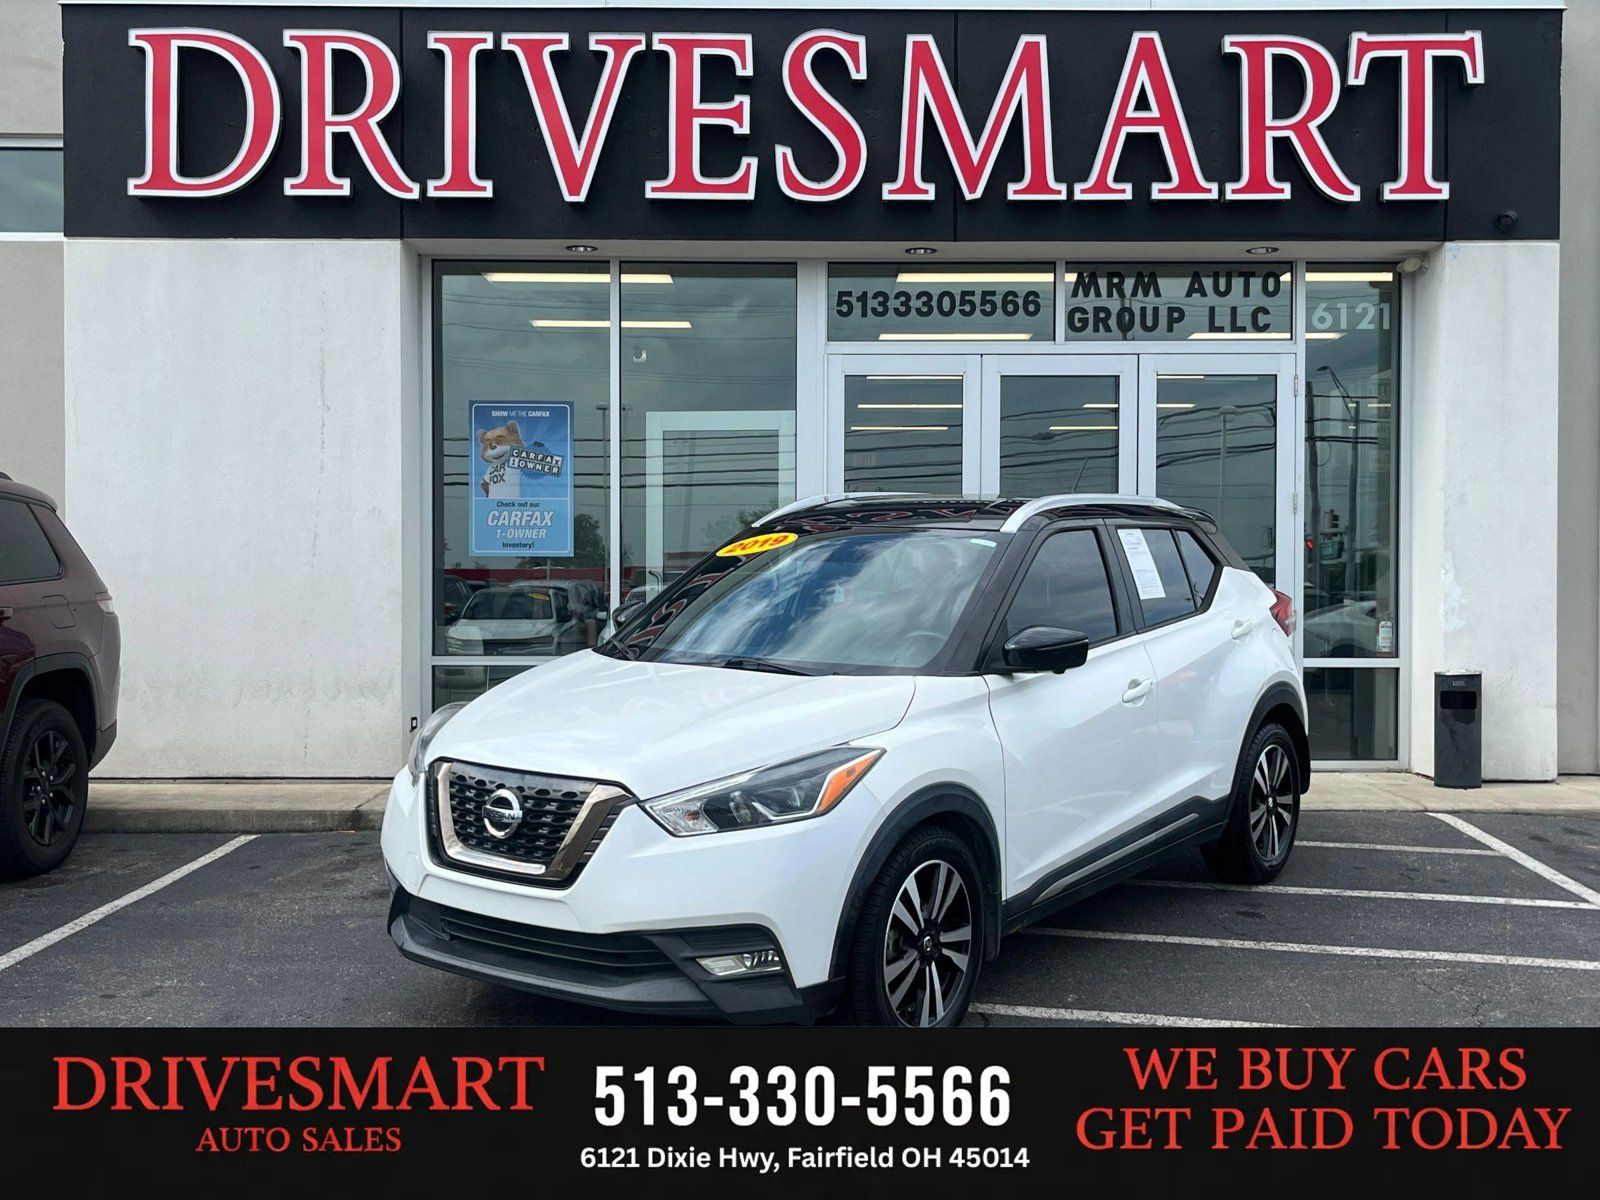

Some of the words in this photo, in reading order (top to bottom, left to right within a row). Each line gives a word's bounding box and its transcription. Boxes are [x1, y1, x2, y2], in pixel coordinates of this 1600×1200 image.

[127, 27, 1485, 203] DRIVESMART
[1071, 271, 1162, 298] MRM
[1185, 271, 1281, 298] AUTO
[836, 290, 1041, 318] 5133305566
[1067, 306, 1186, 333] GROUP
[1208, 306, 1271, 333] LLC
[1311, 302, 1390, 330] 6121
[512, 449, 561, 465] CARFAX
[489, 463, 506, 475] CAR
[519, 460, 559, 474] OWNER
[489, 473, 506, 484] FOX
[496, 500, 516, 508] Check
[487, 510, 554, 527] CARFAX
[496, 528, 547, 539] 1-OWNER
[502, 541, 535, 550] Inventory!
[723, 534, 789, 554] 2019
